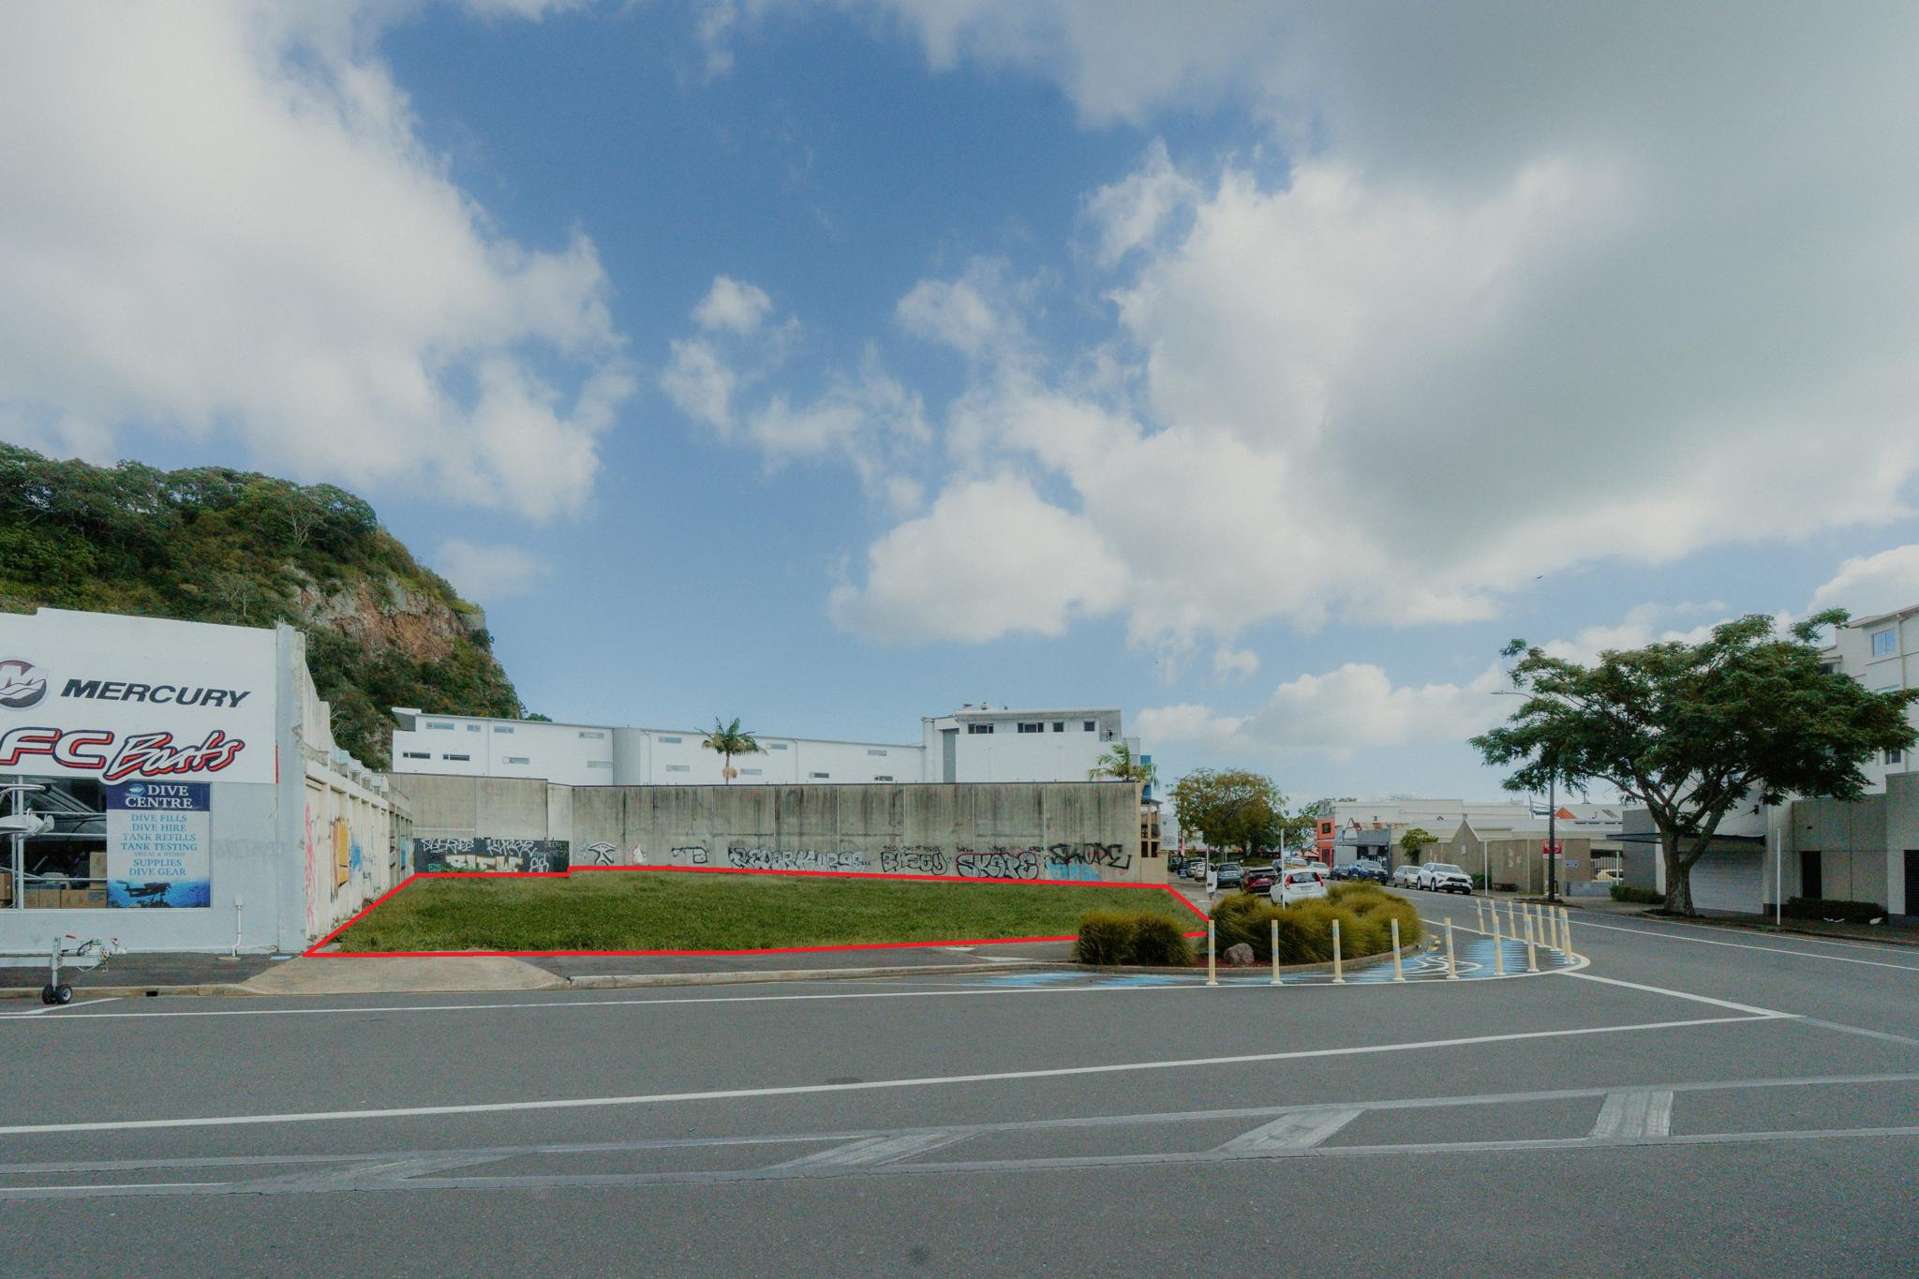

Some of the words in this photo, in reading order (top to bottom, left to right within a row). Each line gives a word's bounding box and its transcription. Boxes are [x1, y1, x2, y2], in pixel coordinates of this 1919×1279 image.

[60, 678, 252, 709] MERCURY
[103, 730, 246, 780] Boats
[147, 784, 189, 796] DIVE
[125, 796, 193, 809] CENTRE
[131, 814, 157, 822] DIVE
[132, 823, 157, 831] DIVE
[161, 823, 186, 832] HIRE
[122, 833, 153, 841] TANK
[155, 833, 197, 841] REFILLS
[121, 842, 151, 851] TANK
[154, 842, 198, 851] TESTING
[133, 859, 182, 867] SUPPLIES
[129, 868, 156, 876] DIVE
[158, 868, 186, 876] GEAR
